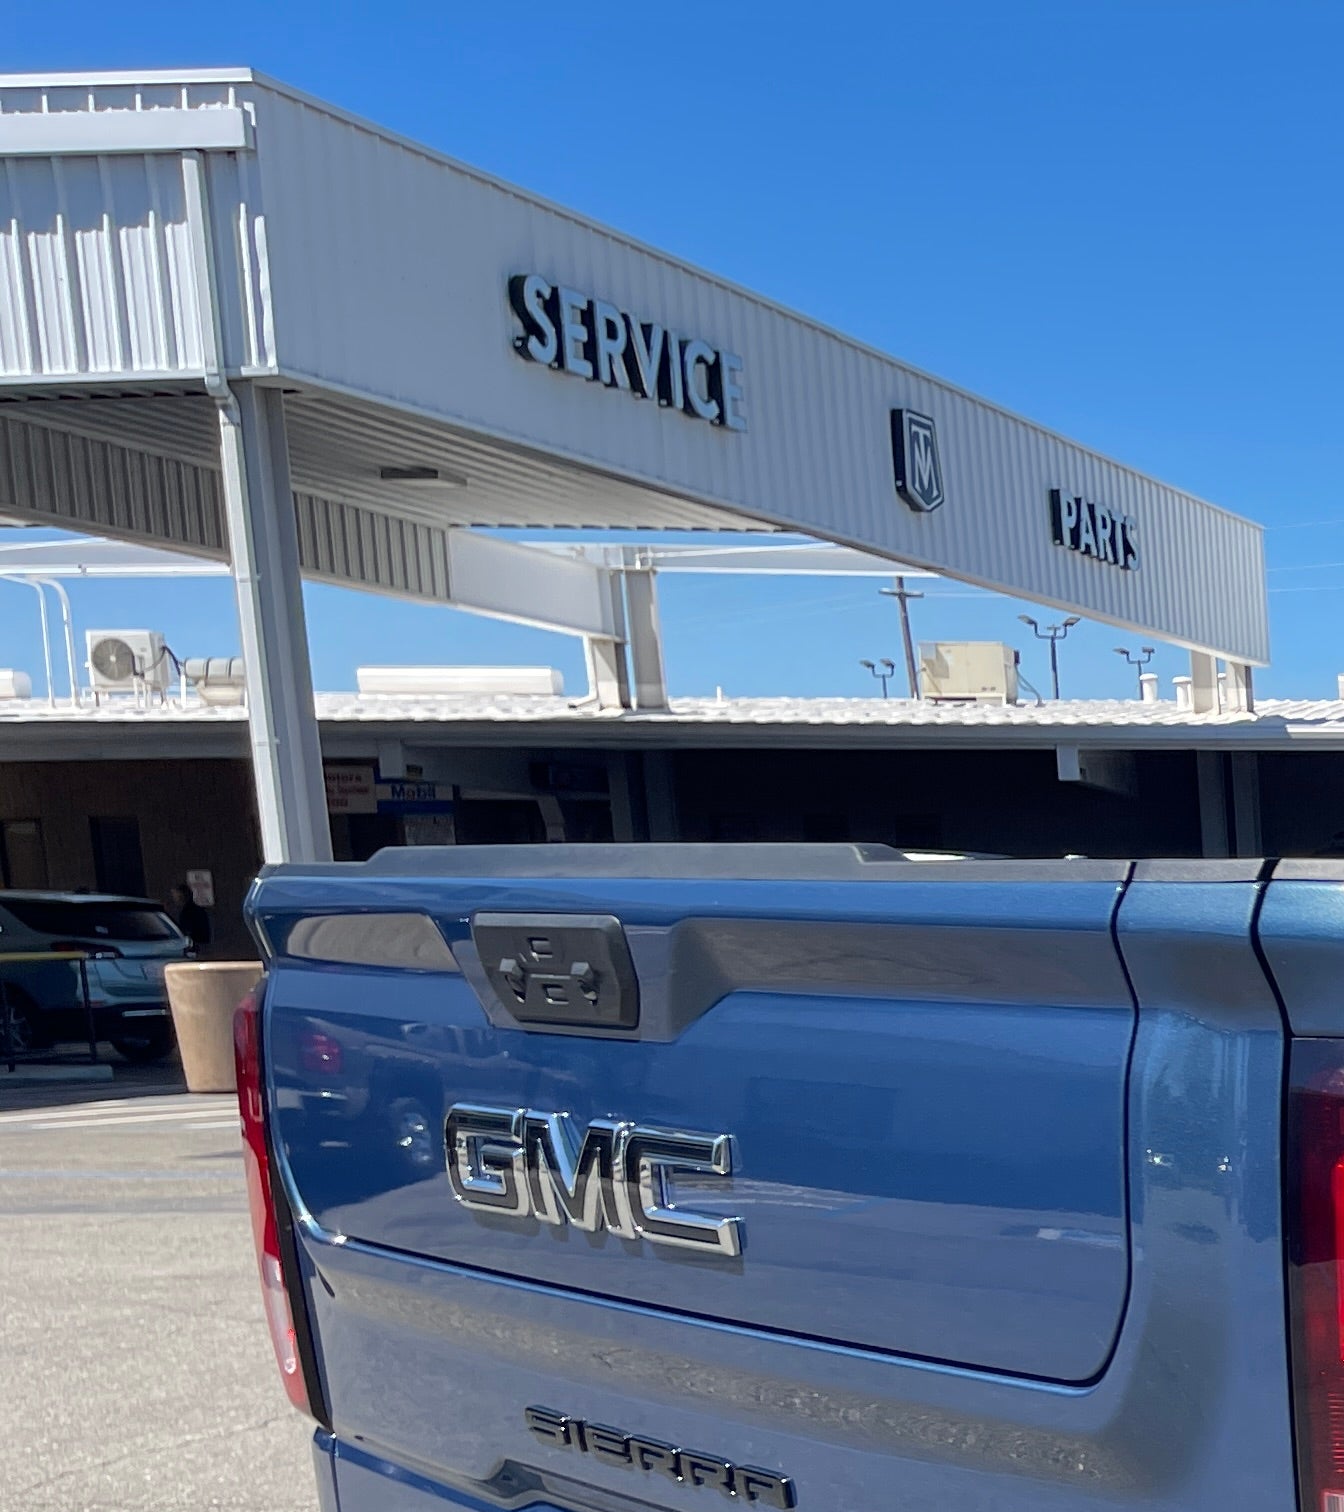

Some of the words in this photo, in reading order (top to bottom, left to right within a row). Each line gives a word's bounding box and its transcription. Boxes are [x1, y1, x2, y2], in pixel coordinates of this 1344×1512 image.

[509, 274, 748, 433] SERVICE
[1050, 487, 1140, 572] PARTS
[443, 1101, 746, 1258] GMC
[525, 1404, 798, 1510] SIERRA
